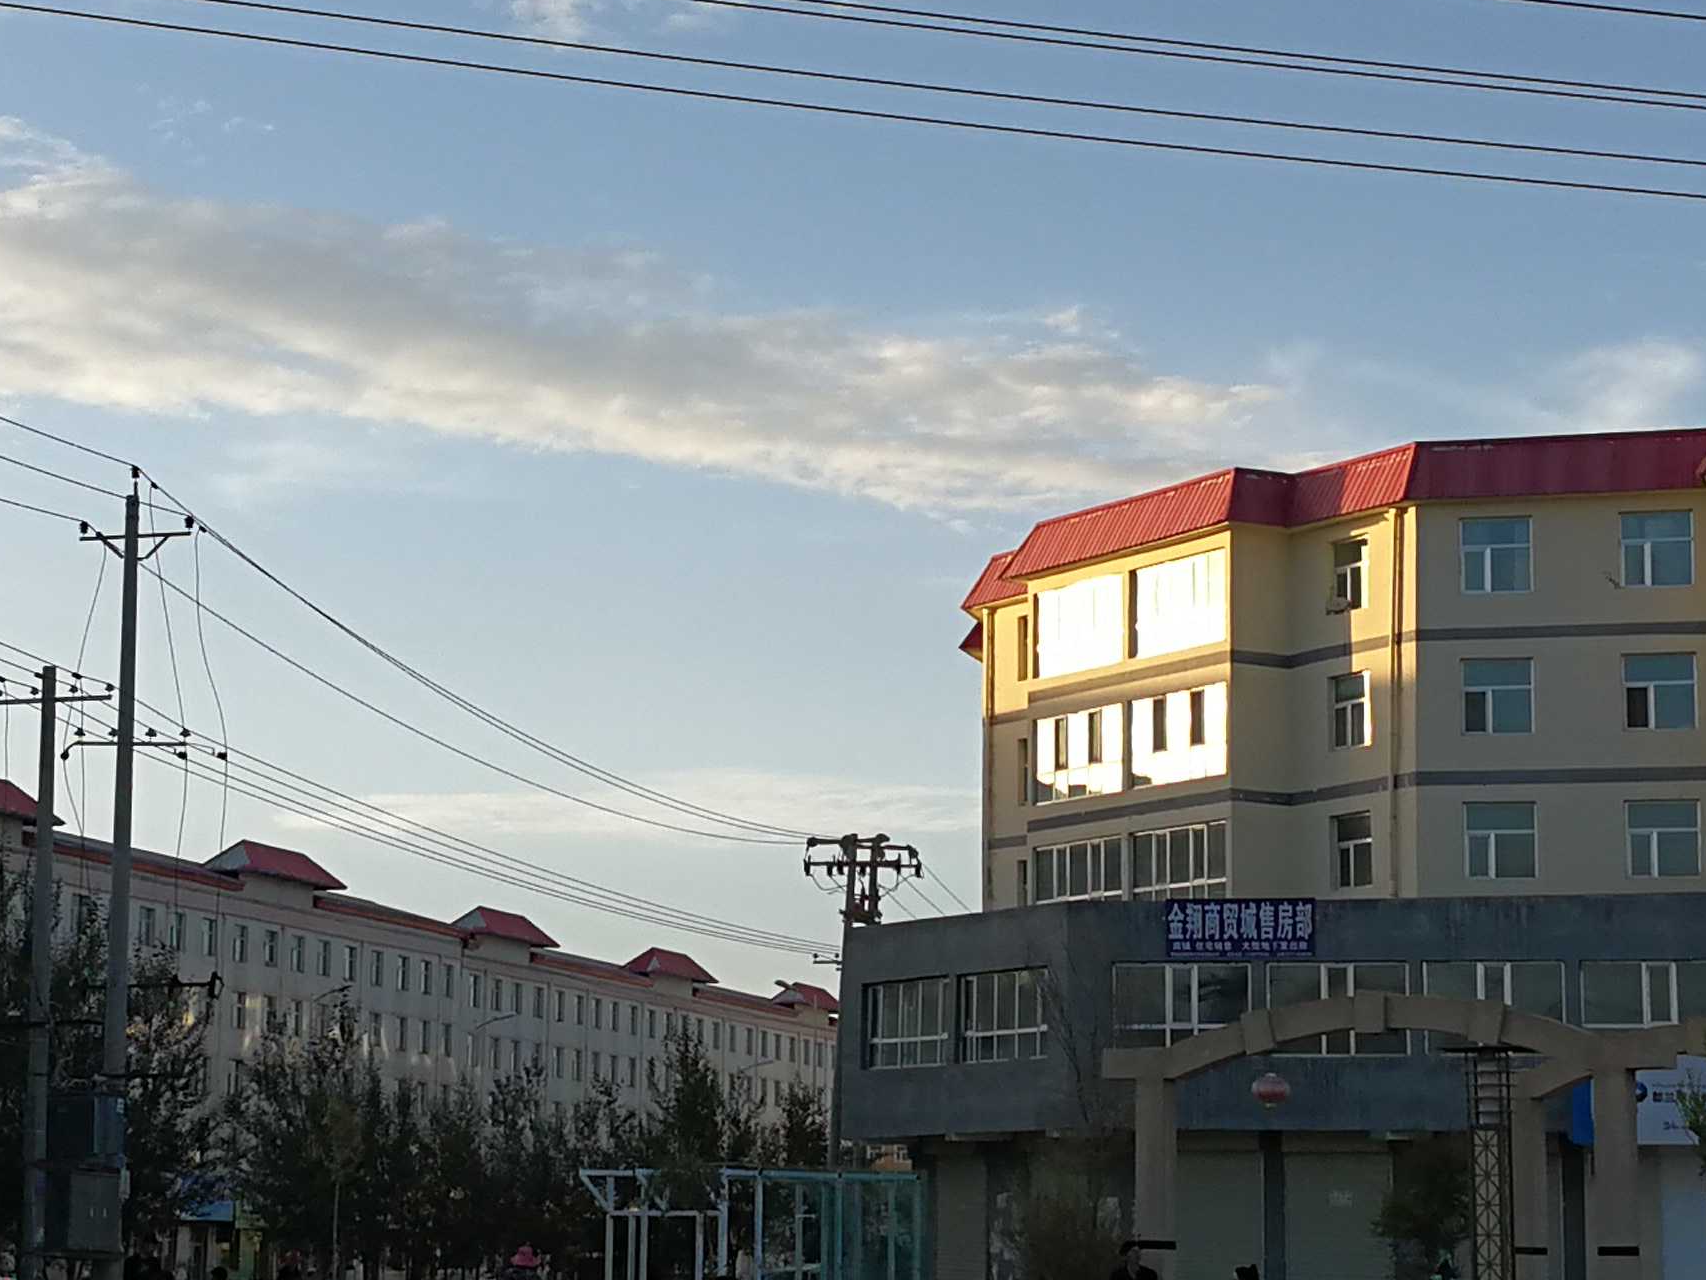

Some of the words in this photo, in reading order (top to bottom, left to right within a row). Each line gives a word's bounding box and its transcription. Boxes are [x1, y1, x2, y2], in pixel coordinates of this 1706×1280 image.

[1167, 901, 1313, 940] 金翔商贸城售房部
